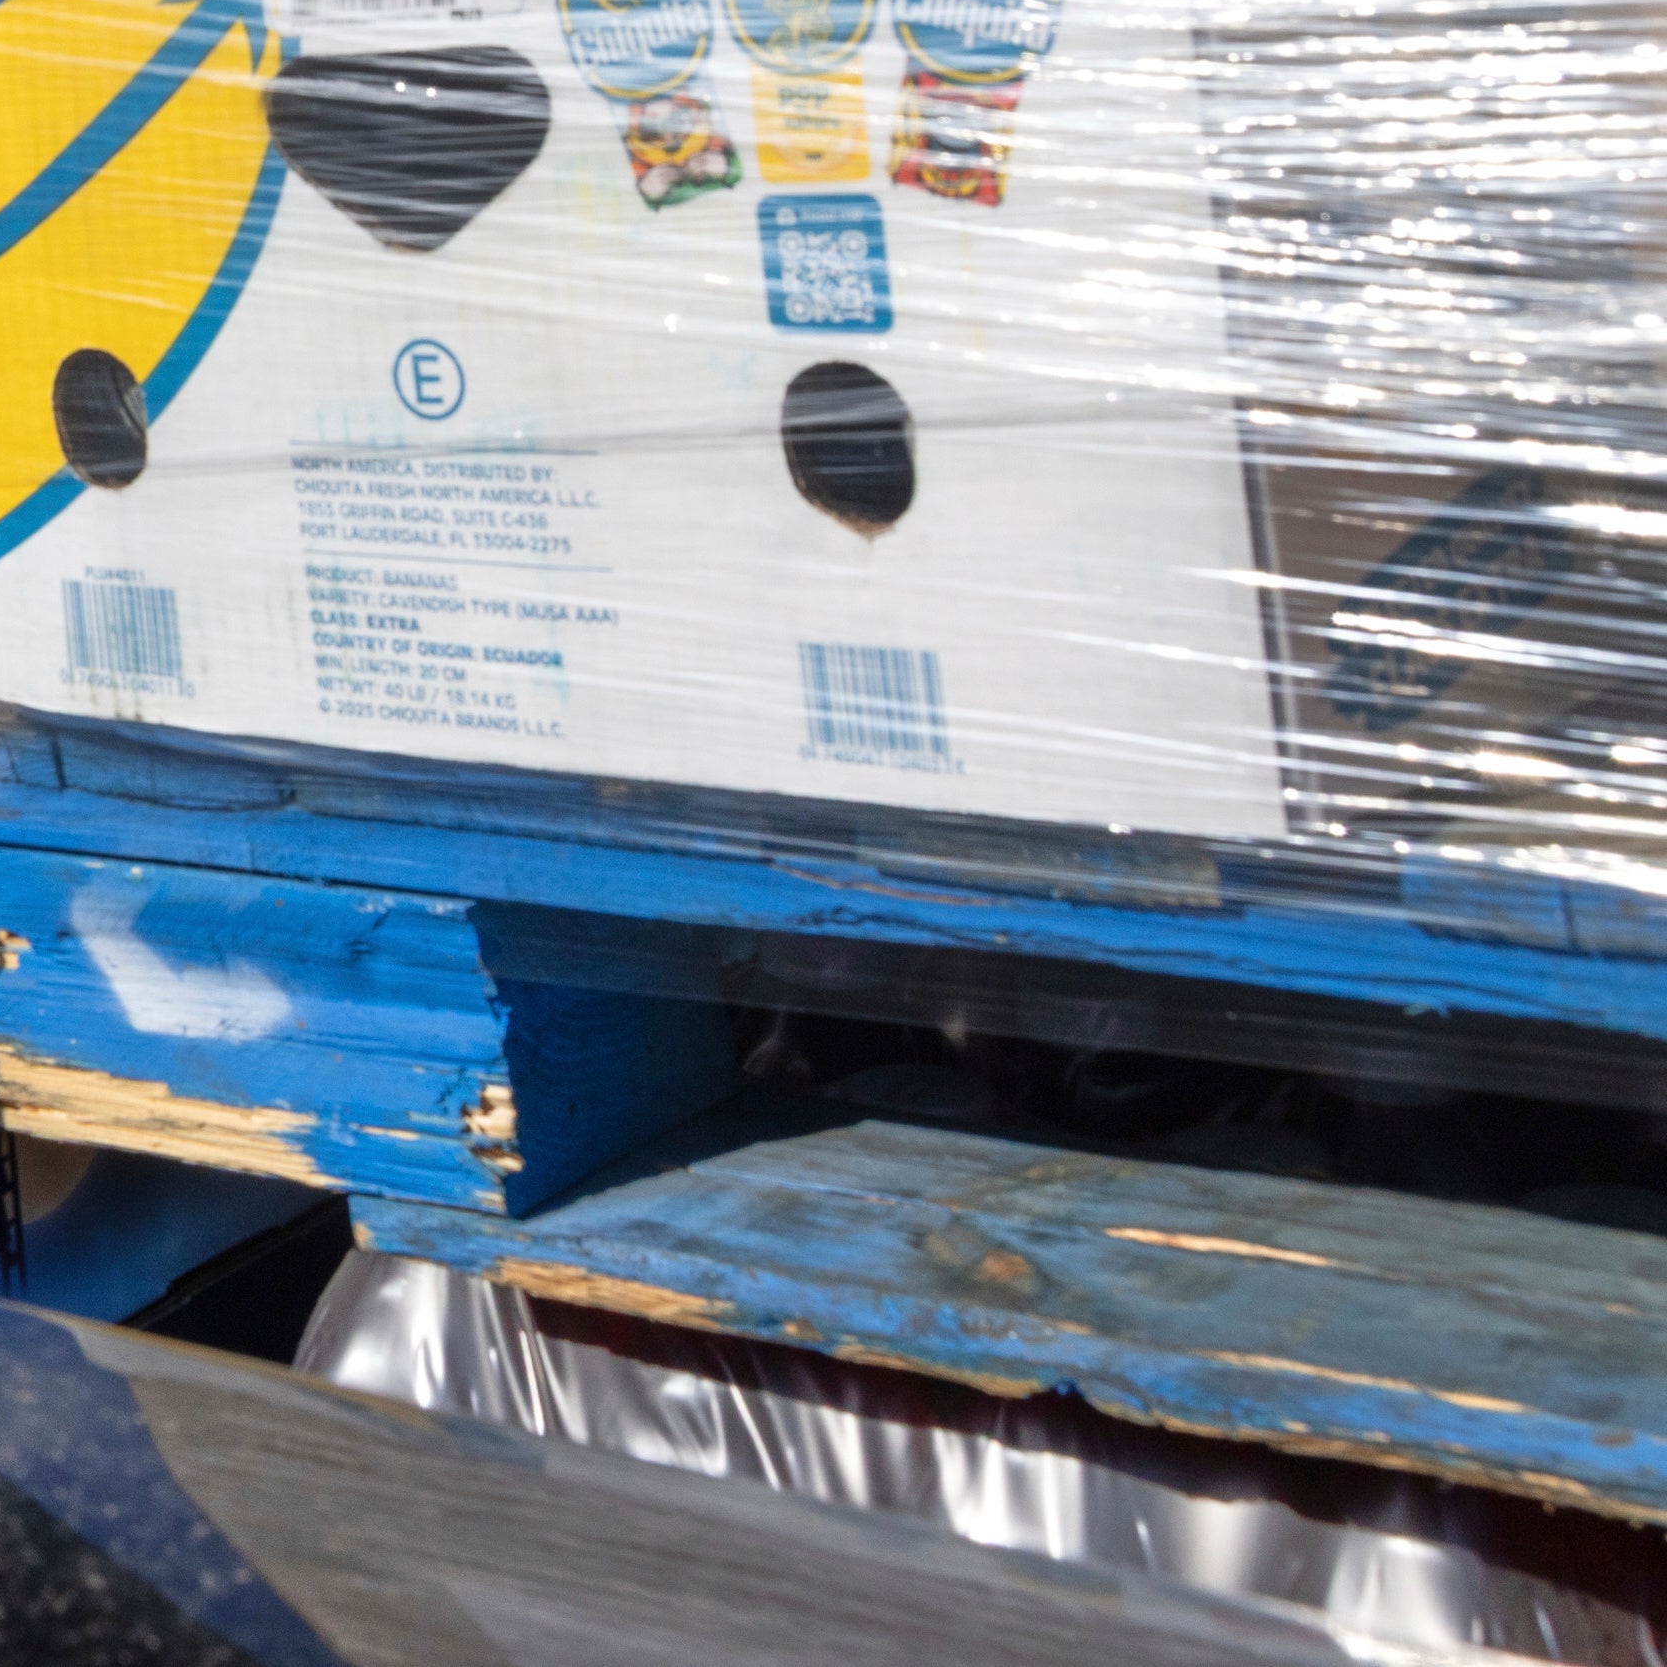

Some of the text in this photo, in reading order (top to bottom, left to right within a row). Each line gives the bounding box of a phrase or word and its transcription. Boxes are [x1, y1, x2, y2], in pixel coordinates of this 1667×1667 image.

[411, 353, 444, 405] E
[291, 455, 343, 472] NORTH
[423, 462, 527, 483] DISTRIBUTED
[294, 478, 363, 497] CHIQUITA
[368, 482, 416, 499] FRESH
[420, 485, 475, 503] NORTH
[480, 488, 551, 506] AMERICA
[299, 522, 337, 540] FORT
[453, 509, 497, 528] SUITE
[382, 569, 459, 593] BANANAS
[378, 593, 467, 614] CAVENDISH
[471, 599, 512, 618] TYPE
[367, 613, 421, 633] EXTRA
[313, 632, 387, 653] COUNTRY
[392, 637, 413, 654] OF
[483, 646, 563, 668] ECUADOR
[419, 663, 439, 680] 20
[442, 665, 467, 682] CM
[317, 676, 346, 693] NET
[384, 683, 404, 700] 40
[408, 685, 428, 702] LB
[494, 692, 518, 710] KG
[378, 705, 452, 728] CHIQUITA
[455, 711, 520, 734] BRANDS
